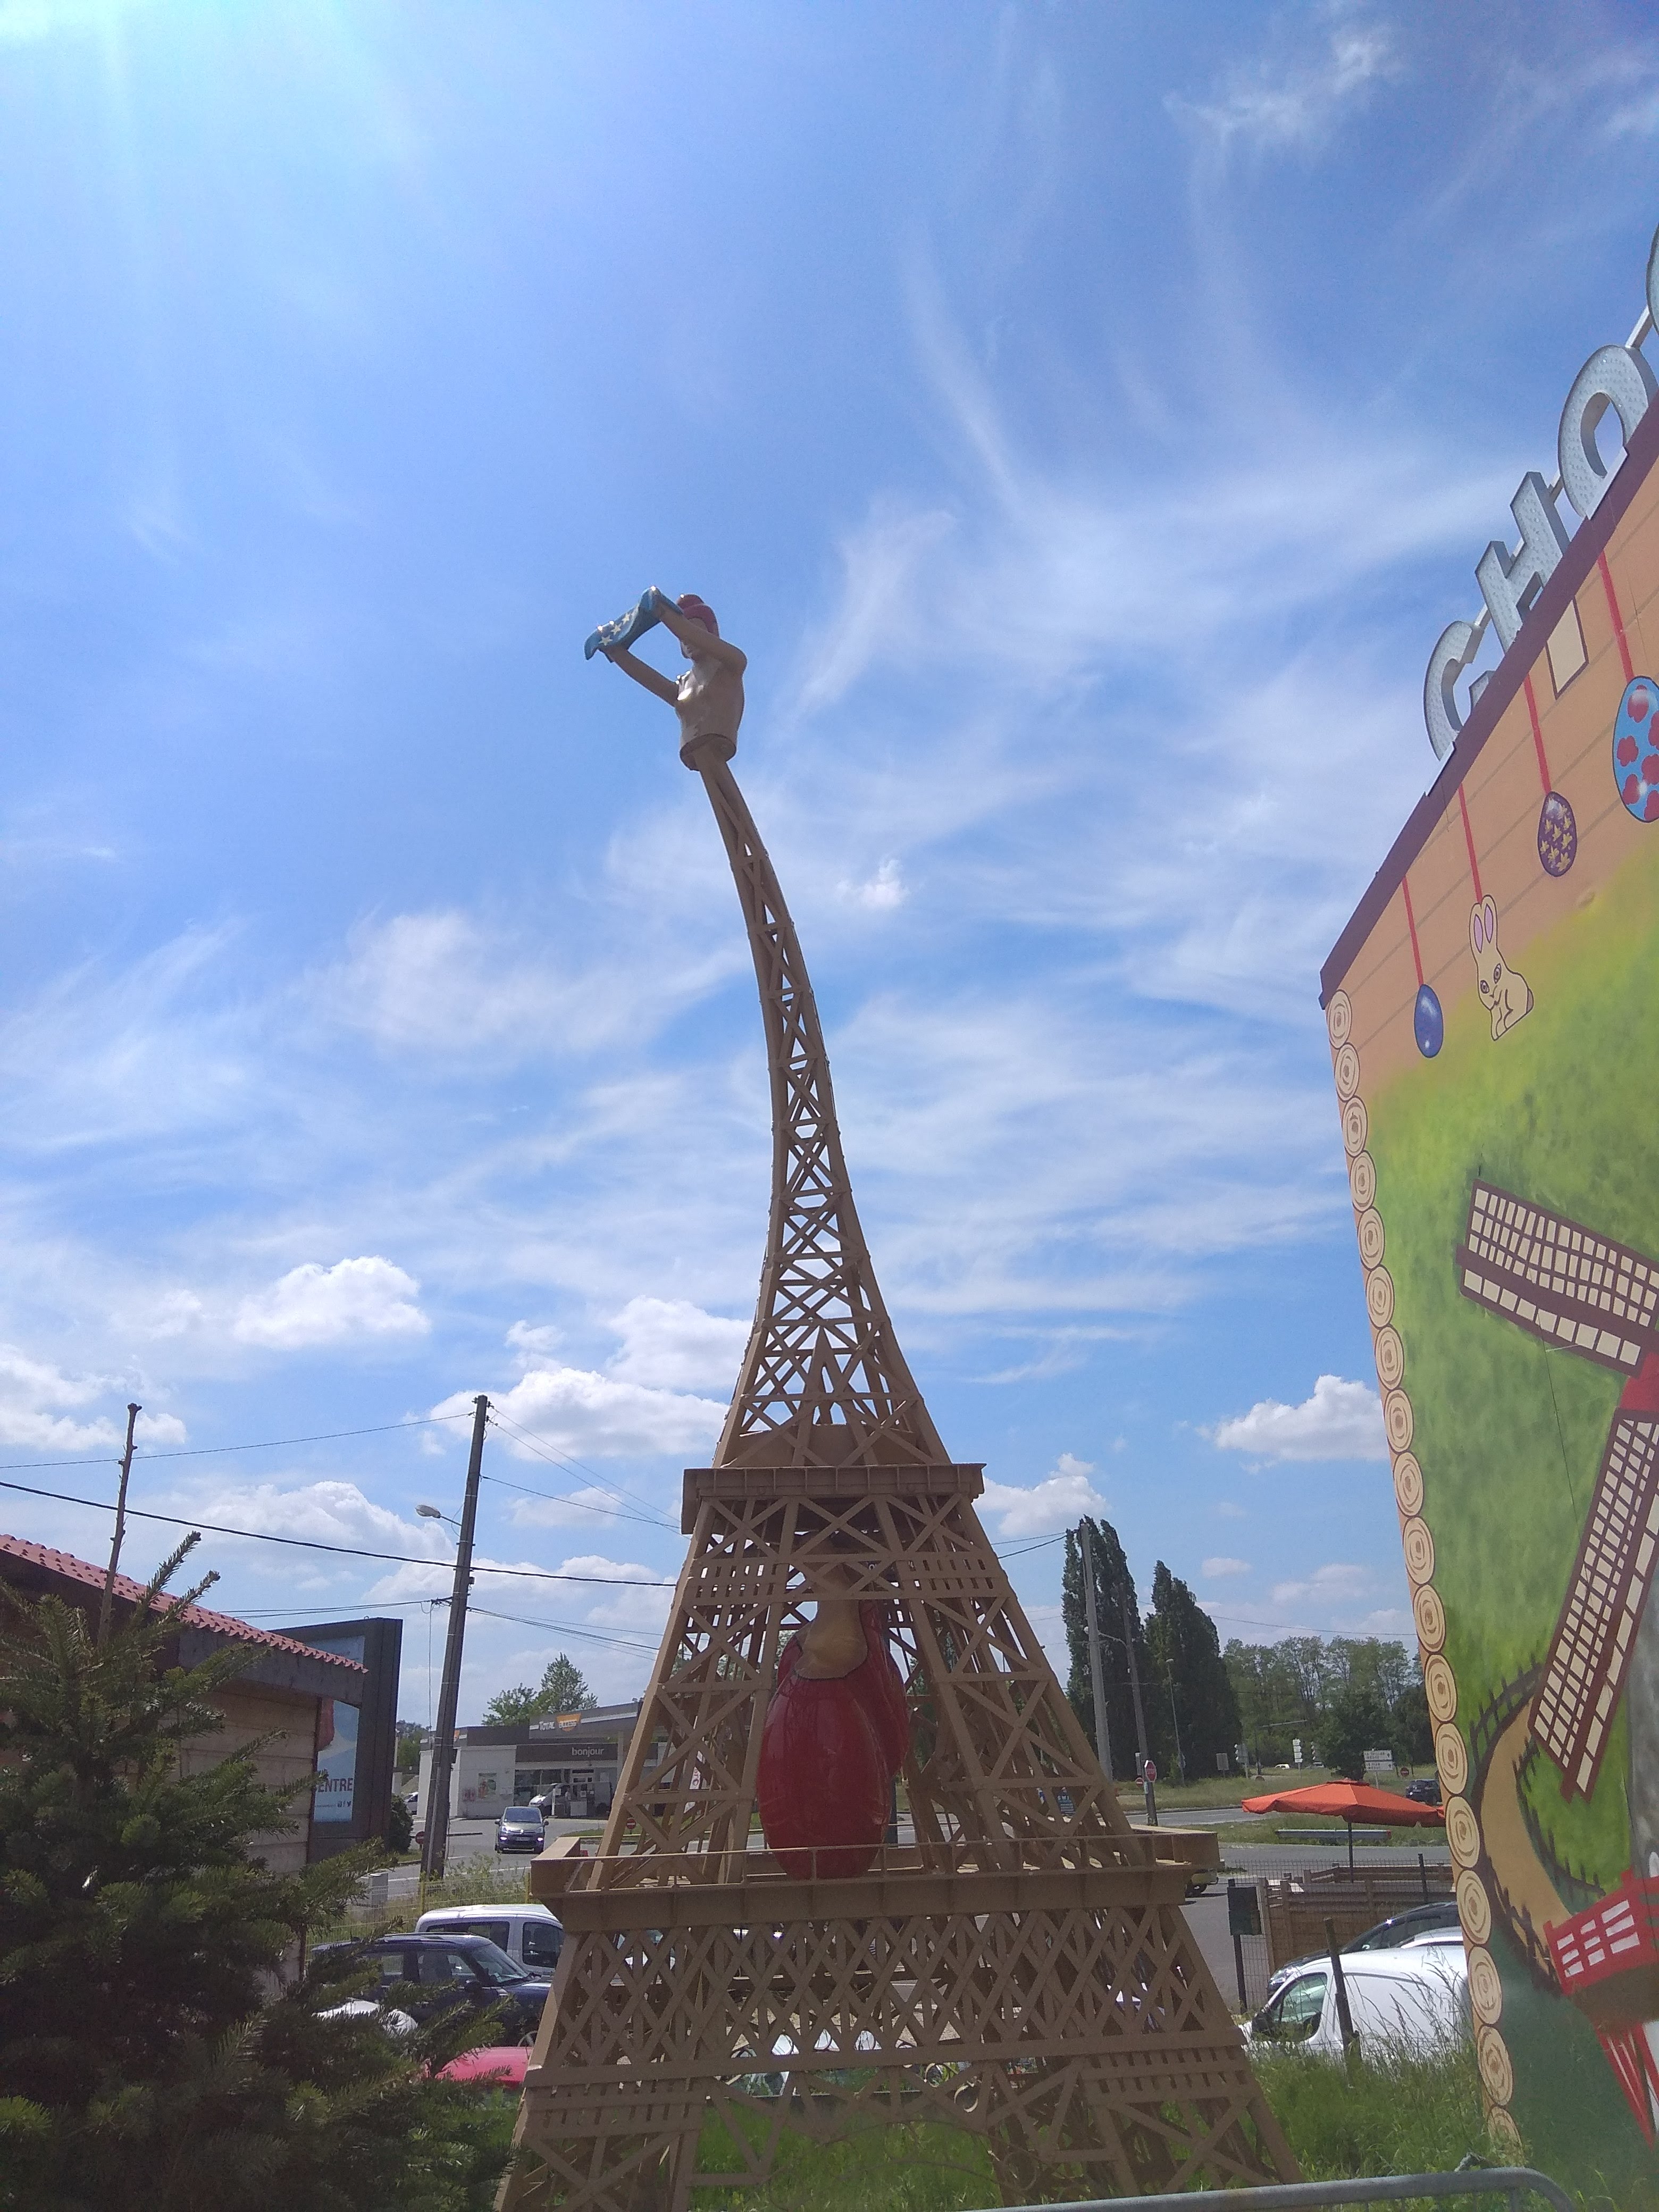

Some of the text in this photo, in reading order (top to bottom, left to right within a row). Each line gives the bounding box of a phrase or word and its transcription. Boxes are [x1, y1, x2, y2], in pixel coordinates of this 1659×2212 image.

[1423, 222, 1659, 762] CHO
[539, 1721, 555, 1731] TOTAL
[572, 1746, 605, 1757] bonjour
[315, 1778, 353, 1792] ENTRE
